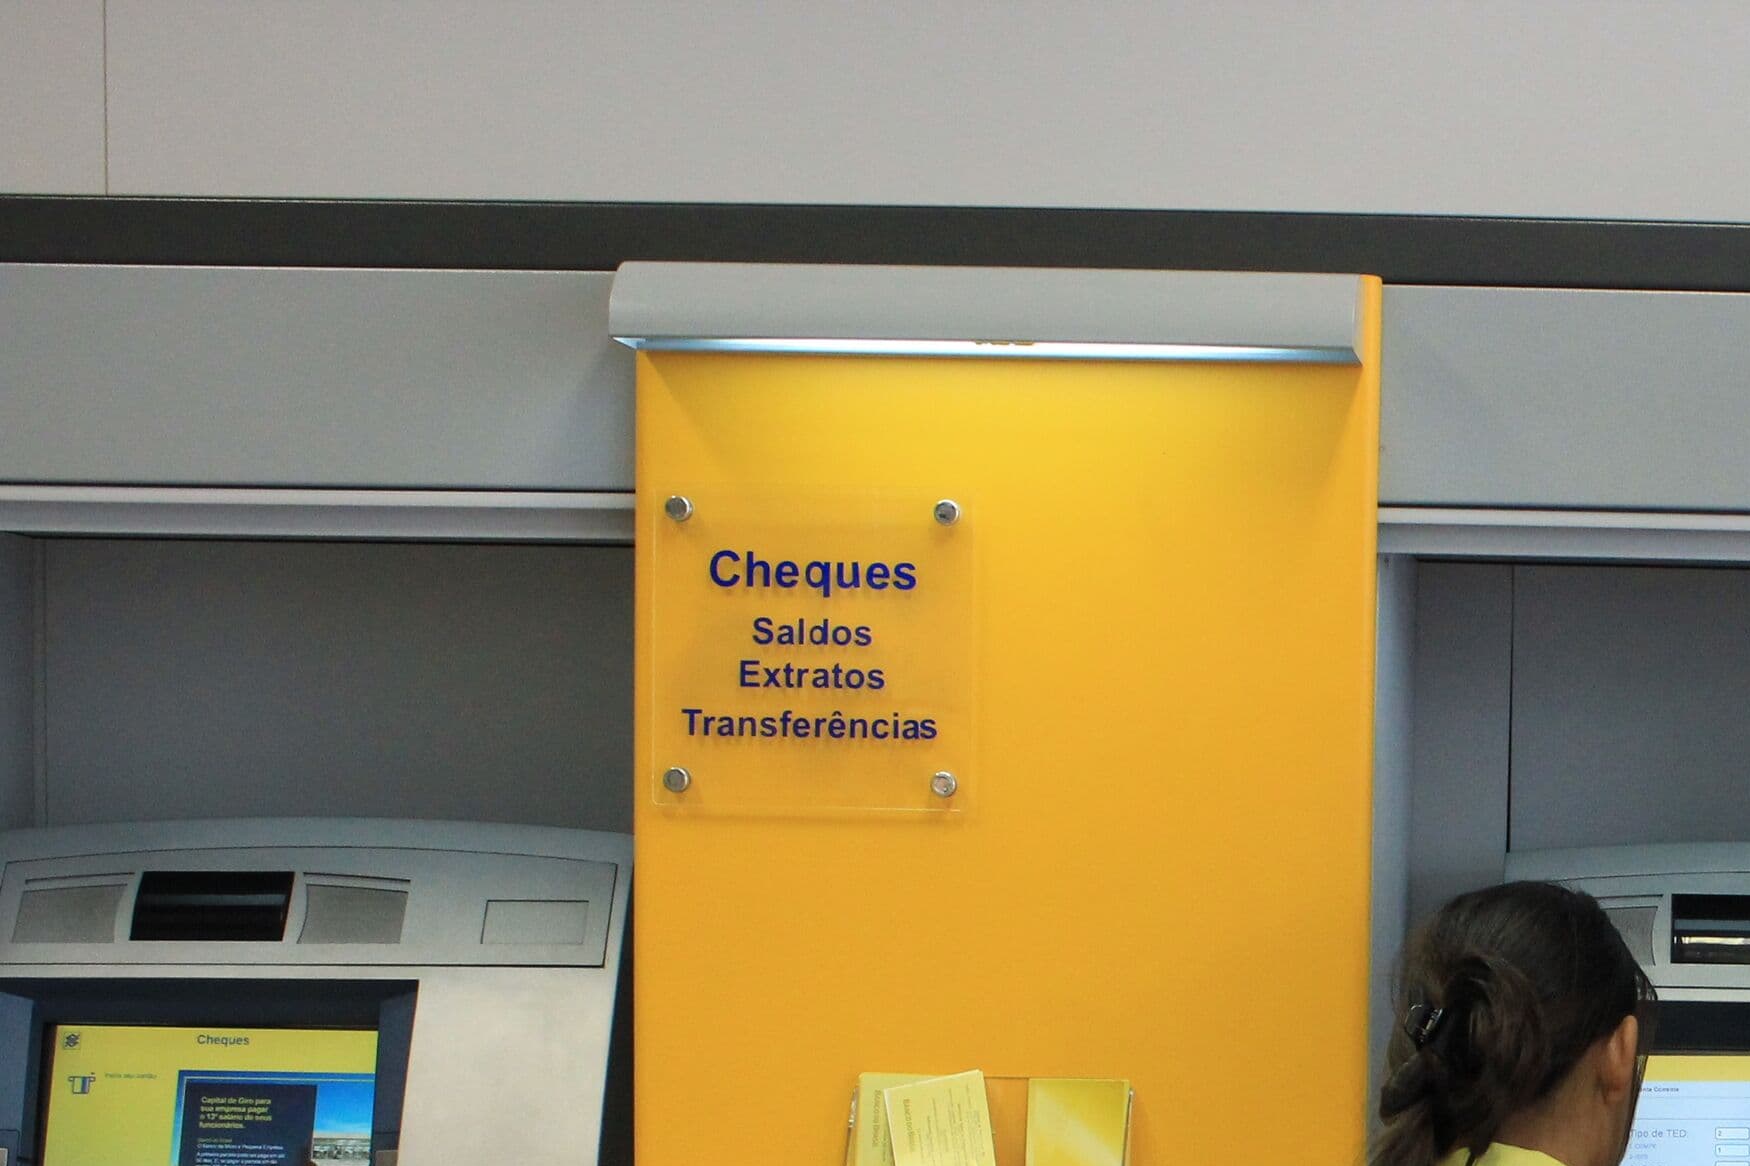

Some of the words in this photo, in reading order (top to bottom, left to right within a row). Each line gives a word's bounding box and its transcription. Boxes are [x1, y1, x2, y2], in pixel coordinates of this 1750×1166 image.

[709, 549, 917, 597] Cheques
[752, 616, 873, 647] Saldos
[739, 659, 885, 690] Extratos
[681, 708, 938, 740] Transferências
[197, 1034, 250, 1047] Cheques
[201, 1096, 227, 1105] Capital
[1630, 1128, 1649, 1139] Tipo
[1651, 1129, 1663, 1138] de
